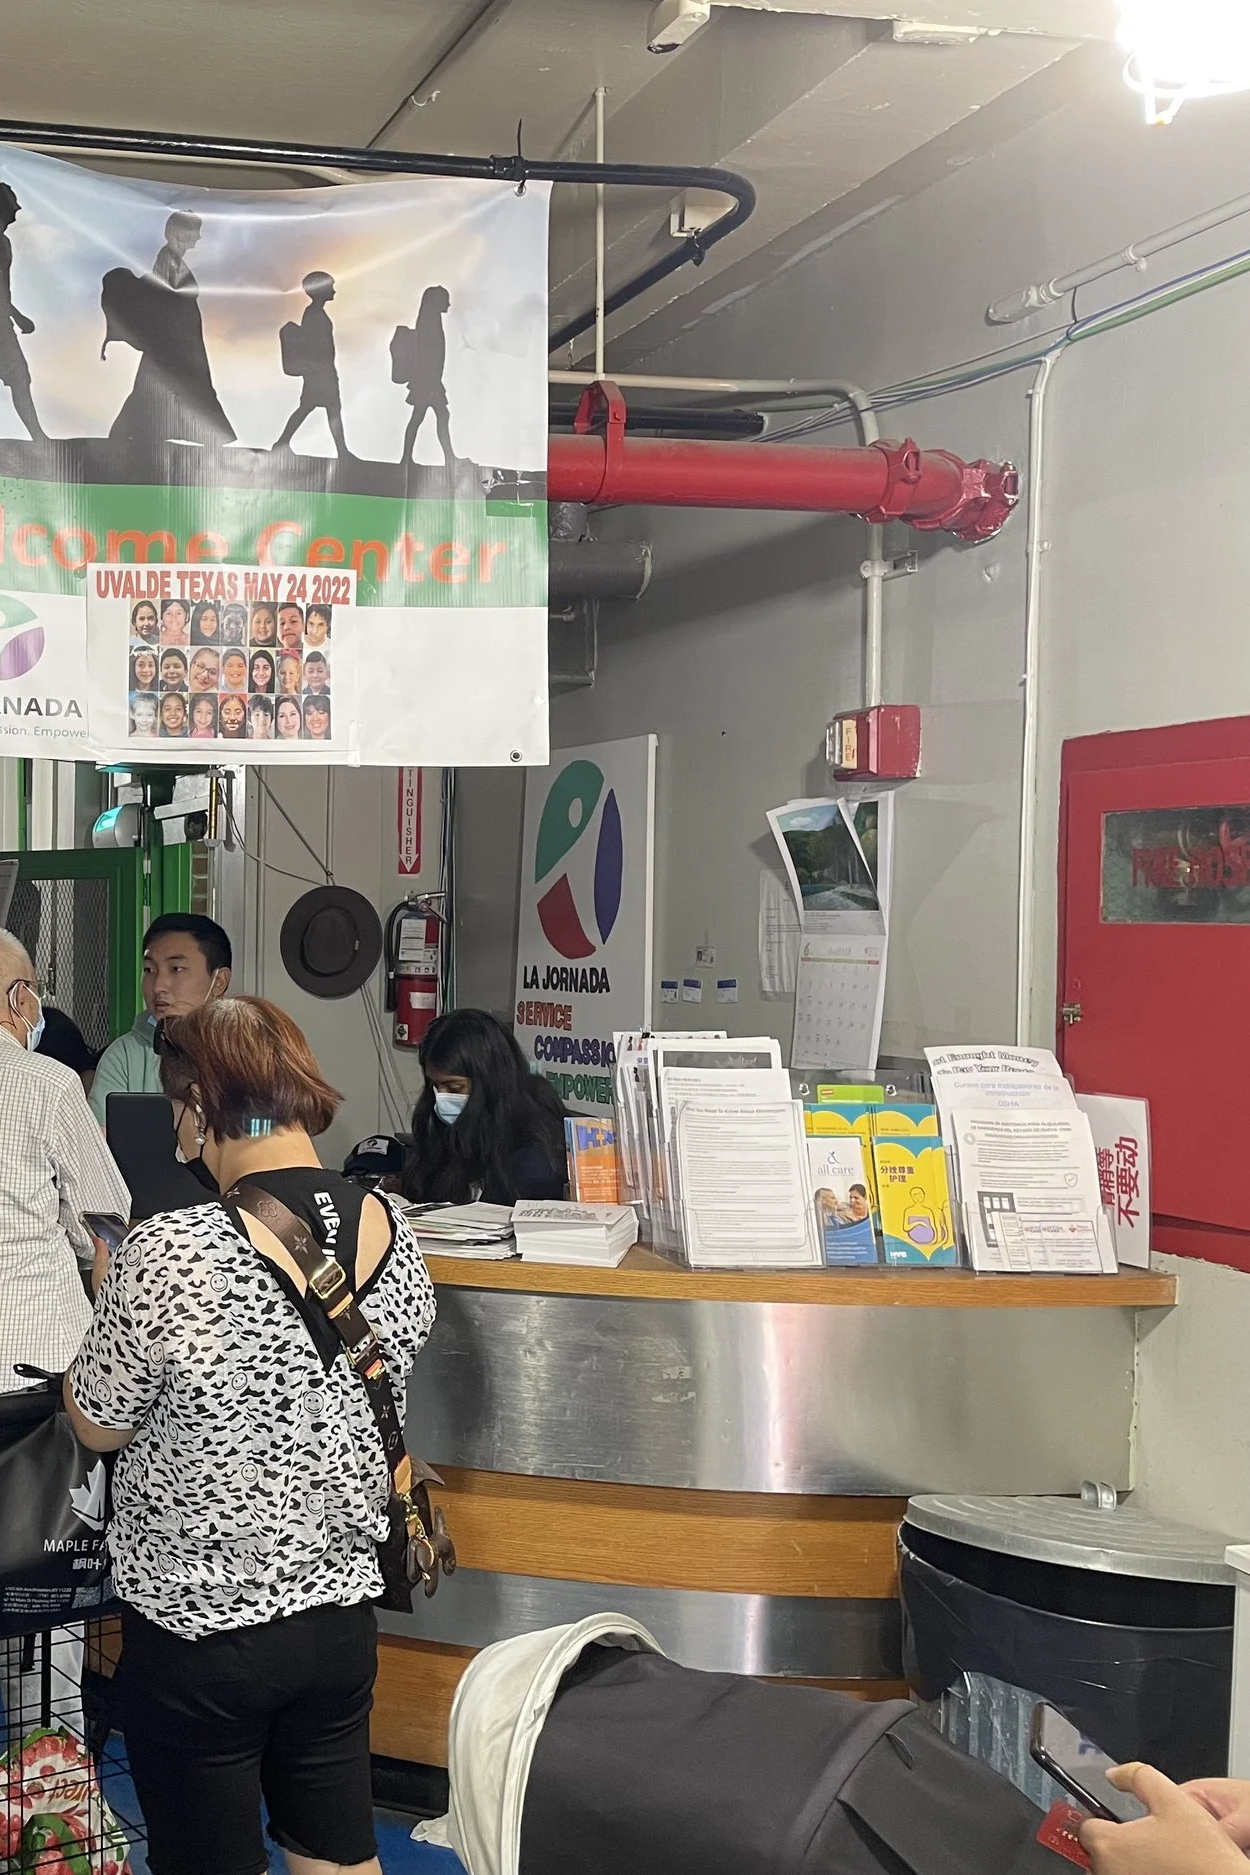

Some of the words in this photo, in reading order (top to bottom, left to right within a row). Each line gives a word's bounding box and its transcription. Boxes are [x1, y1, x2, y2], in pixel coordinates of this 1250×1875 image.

[257, 521, 508, 584] Center
[95, 569, 171, 600] UVALDE
[177, 570, 238, 602] TEXAS
[245, 572, 284, 603] MAY
[287, 574, 308, 603] 24
[312, 575, 351, 605] 2022
[33, 726, 89, 739] Empowe
[523, 965, 540, 989] LA
[542, 965, 611, 993] JORNADA
[516, 1000, 573, 1031] SERVICE
[831, 1166, 855, 1175] care
[1114, 1136, 1140, 1229] 不要动
[43, 1539, 89, 1552] MAPLE
[72, 1557, 107, 1571] 枫叶
